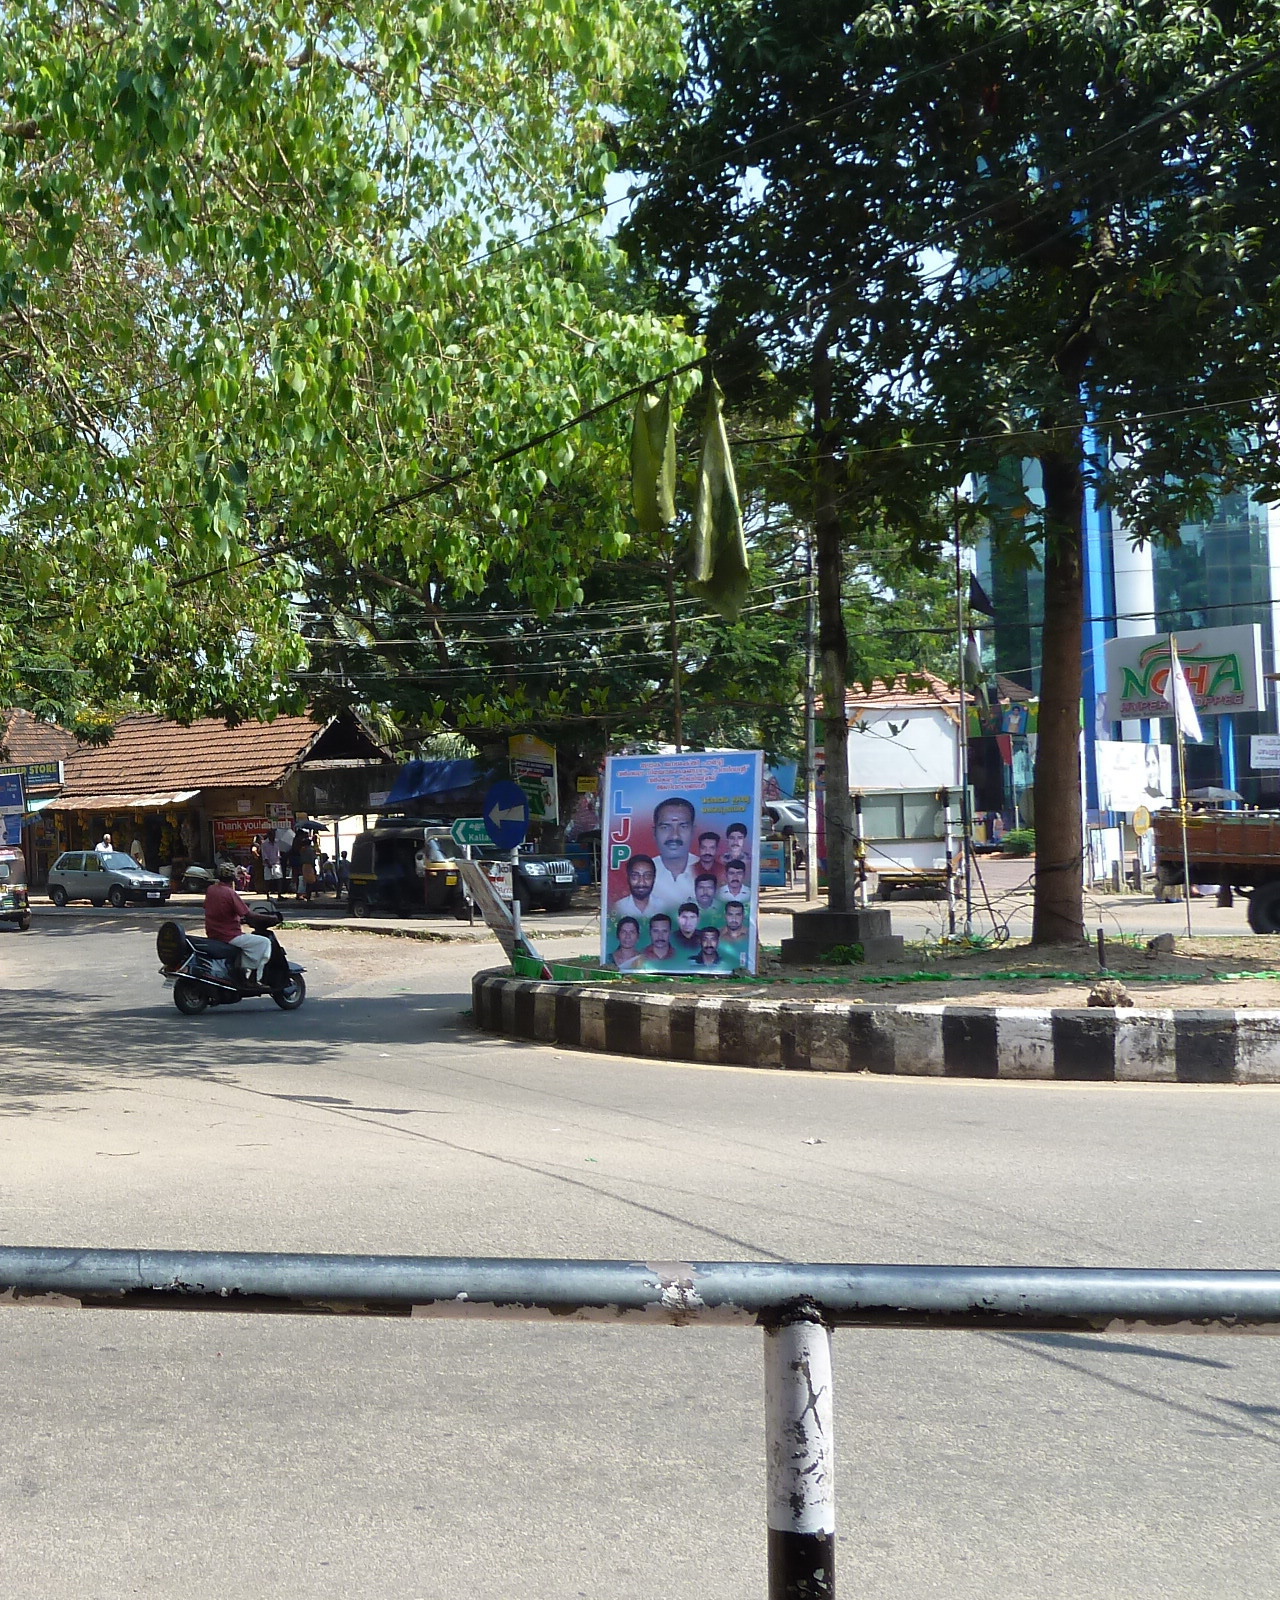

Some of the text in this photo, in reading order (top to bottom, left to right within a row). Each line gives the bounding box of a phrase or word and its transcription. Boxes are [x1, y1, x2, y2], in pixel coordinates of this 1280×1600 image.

[29, 764, 58, 775] STORE
[216, 821, 243, 831] Thank
[468, 833, 491, 841] Kalla
